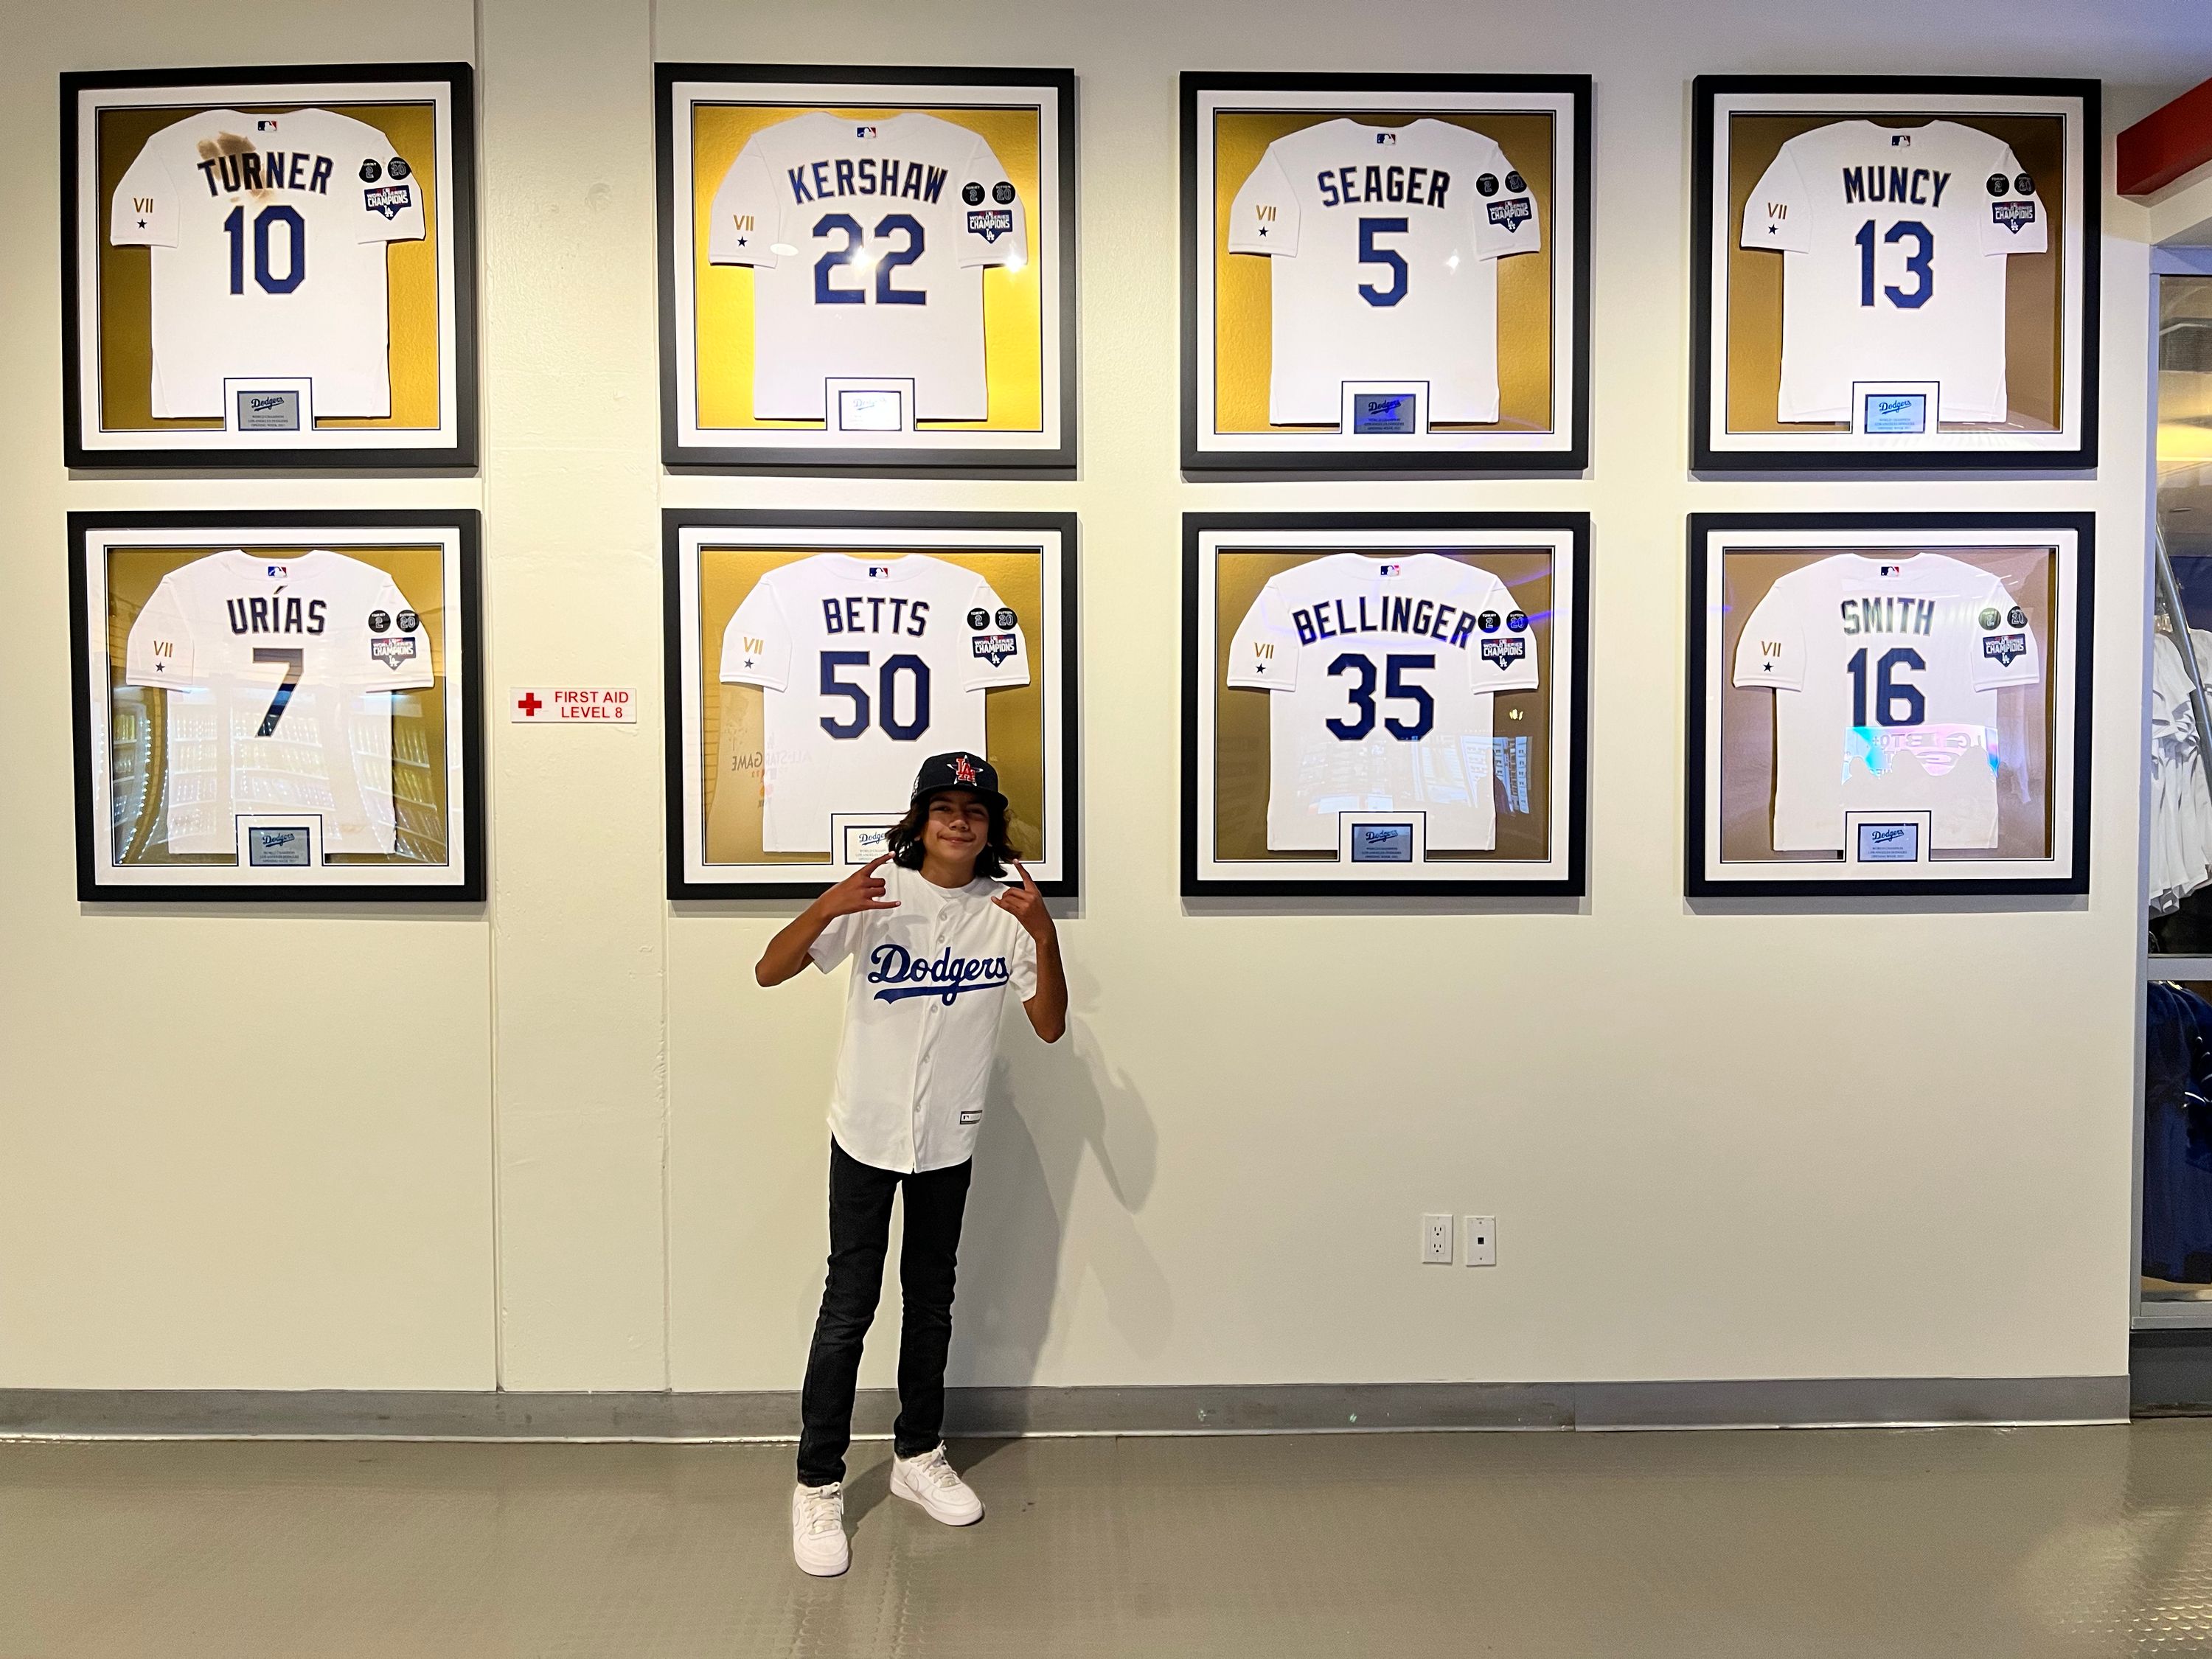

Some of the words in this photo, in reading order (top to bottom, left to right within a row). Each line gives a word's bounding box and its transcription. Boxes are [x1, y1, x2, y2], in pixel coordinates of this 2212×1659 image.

[197, 152, 333, 197] TURNER
[366, 166, 374, 178] 2
[391, 164, 406, 176] 20
[787, 159, 948, 205] KERSHAW
[1317, 165, 1450, 209] SEAGER
[1484, 181, 1492, 192] 2
[1843, 165, 1952, 208] MUNCY
[1994, 181, 2003, 192] 2
[368, 195, 408, 207] CHAMPIONS
[970, 189, 978, 201] 2
[996, 188, 1012, 201] 20
[133, 198, 153, 214] VII
[383, 205, 393, 217] LA
[1491, 206, 1528, 220] CHAMPIONS
[1767, 202, 1787, 220] VII
[1256, 205, 1276, 222] VII
[1996, 210, 2033, 220] CHAMPIONS
[733, 214, 754, 232] VII
[970, 218, 1010, 229] CHAMPIONS
[1506, 218, 1516, 230] LA
[2010, 219, 2019, 230] LA
[986, 229, 995, 240] LA
[223, 205, 305, 295] 10
[812, 213, 927, 305] 22
[1358, 217, 1408, 307] 5
[1854, 219, 1934, 309] 13
[251, 397, 285, 411] Dodgers
[1368, 399, 1402, 414] Dodgers
[1879, 400, 1912, 414] Dodgers
[226, 584, 327, 636] URÍAS
[1841, 597, 1935, 636] SMITH
[375, 617, 383, 628] 2
[400, 616, 416, 628] 20
[822, 597, 930, 638] BETTS
[975, 615, 983, 627] 2
[999, 615, 1014, 626] 20
[1292, 596, 1476, 650] BELLINGER
[1486, 617, 1493, 628] 2
[1510, 617, 1523, 628] 20
[153, 641, 173, 658] VII
[373, 646, 414, 655] CHAMPIONS
[742, 636, 763, 655] VII
[975, 644, 1015, 654] CHAMPIONS
[1253, 641, 1274, 660] VII
[1484, 647, 1523, 656] CHAMPIONS
[1761, 640, 1781, 658] VII
[1986, 643, 2024, 655] CHAMPIONS
[389, 655, 397, 667] LA
[991, 652, 1000, 664] LA
[1499, 655, 1507, 667] LA
[2002, 653, 2010, 664] LA
[252, 647, 304, 738] 7
[1847, 647, 1926, 727] 16
[555, 692, 599, 703] FIRST
[603, 692, 629, 703] AID
[820, 650, 931, 742] 50
[1325, 653, 1436, 742] 35
[561, 706, 611, 718] LEVEL
[615, 707, 623, 718] 8
[956, 757, 975, 782] LA
[262, 833, 295, 847] Dodgers
[859, 832, 886, 845] Dodge
[1366, 830, 1398, 844] Dodgers
[1872, 830, 1905, 844] Dodgers
[868, 944, 1009, 1006] Dodgers
